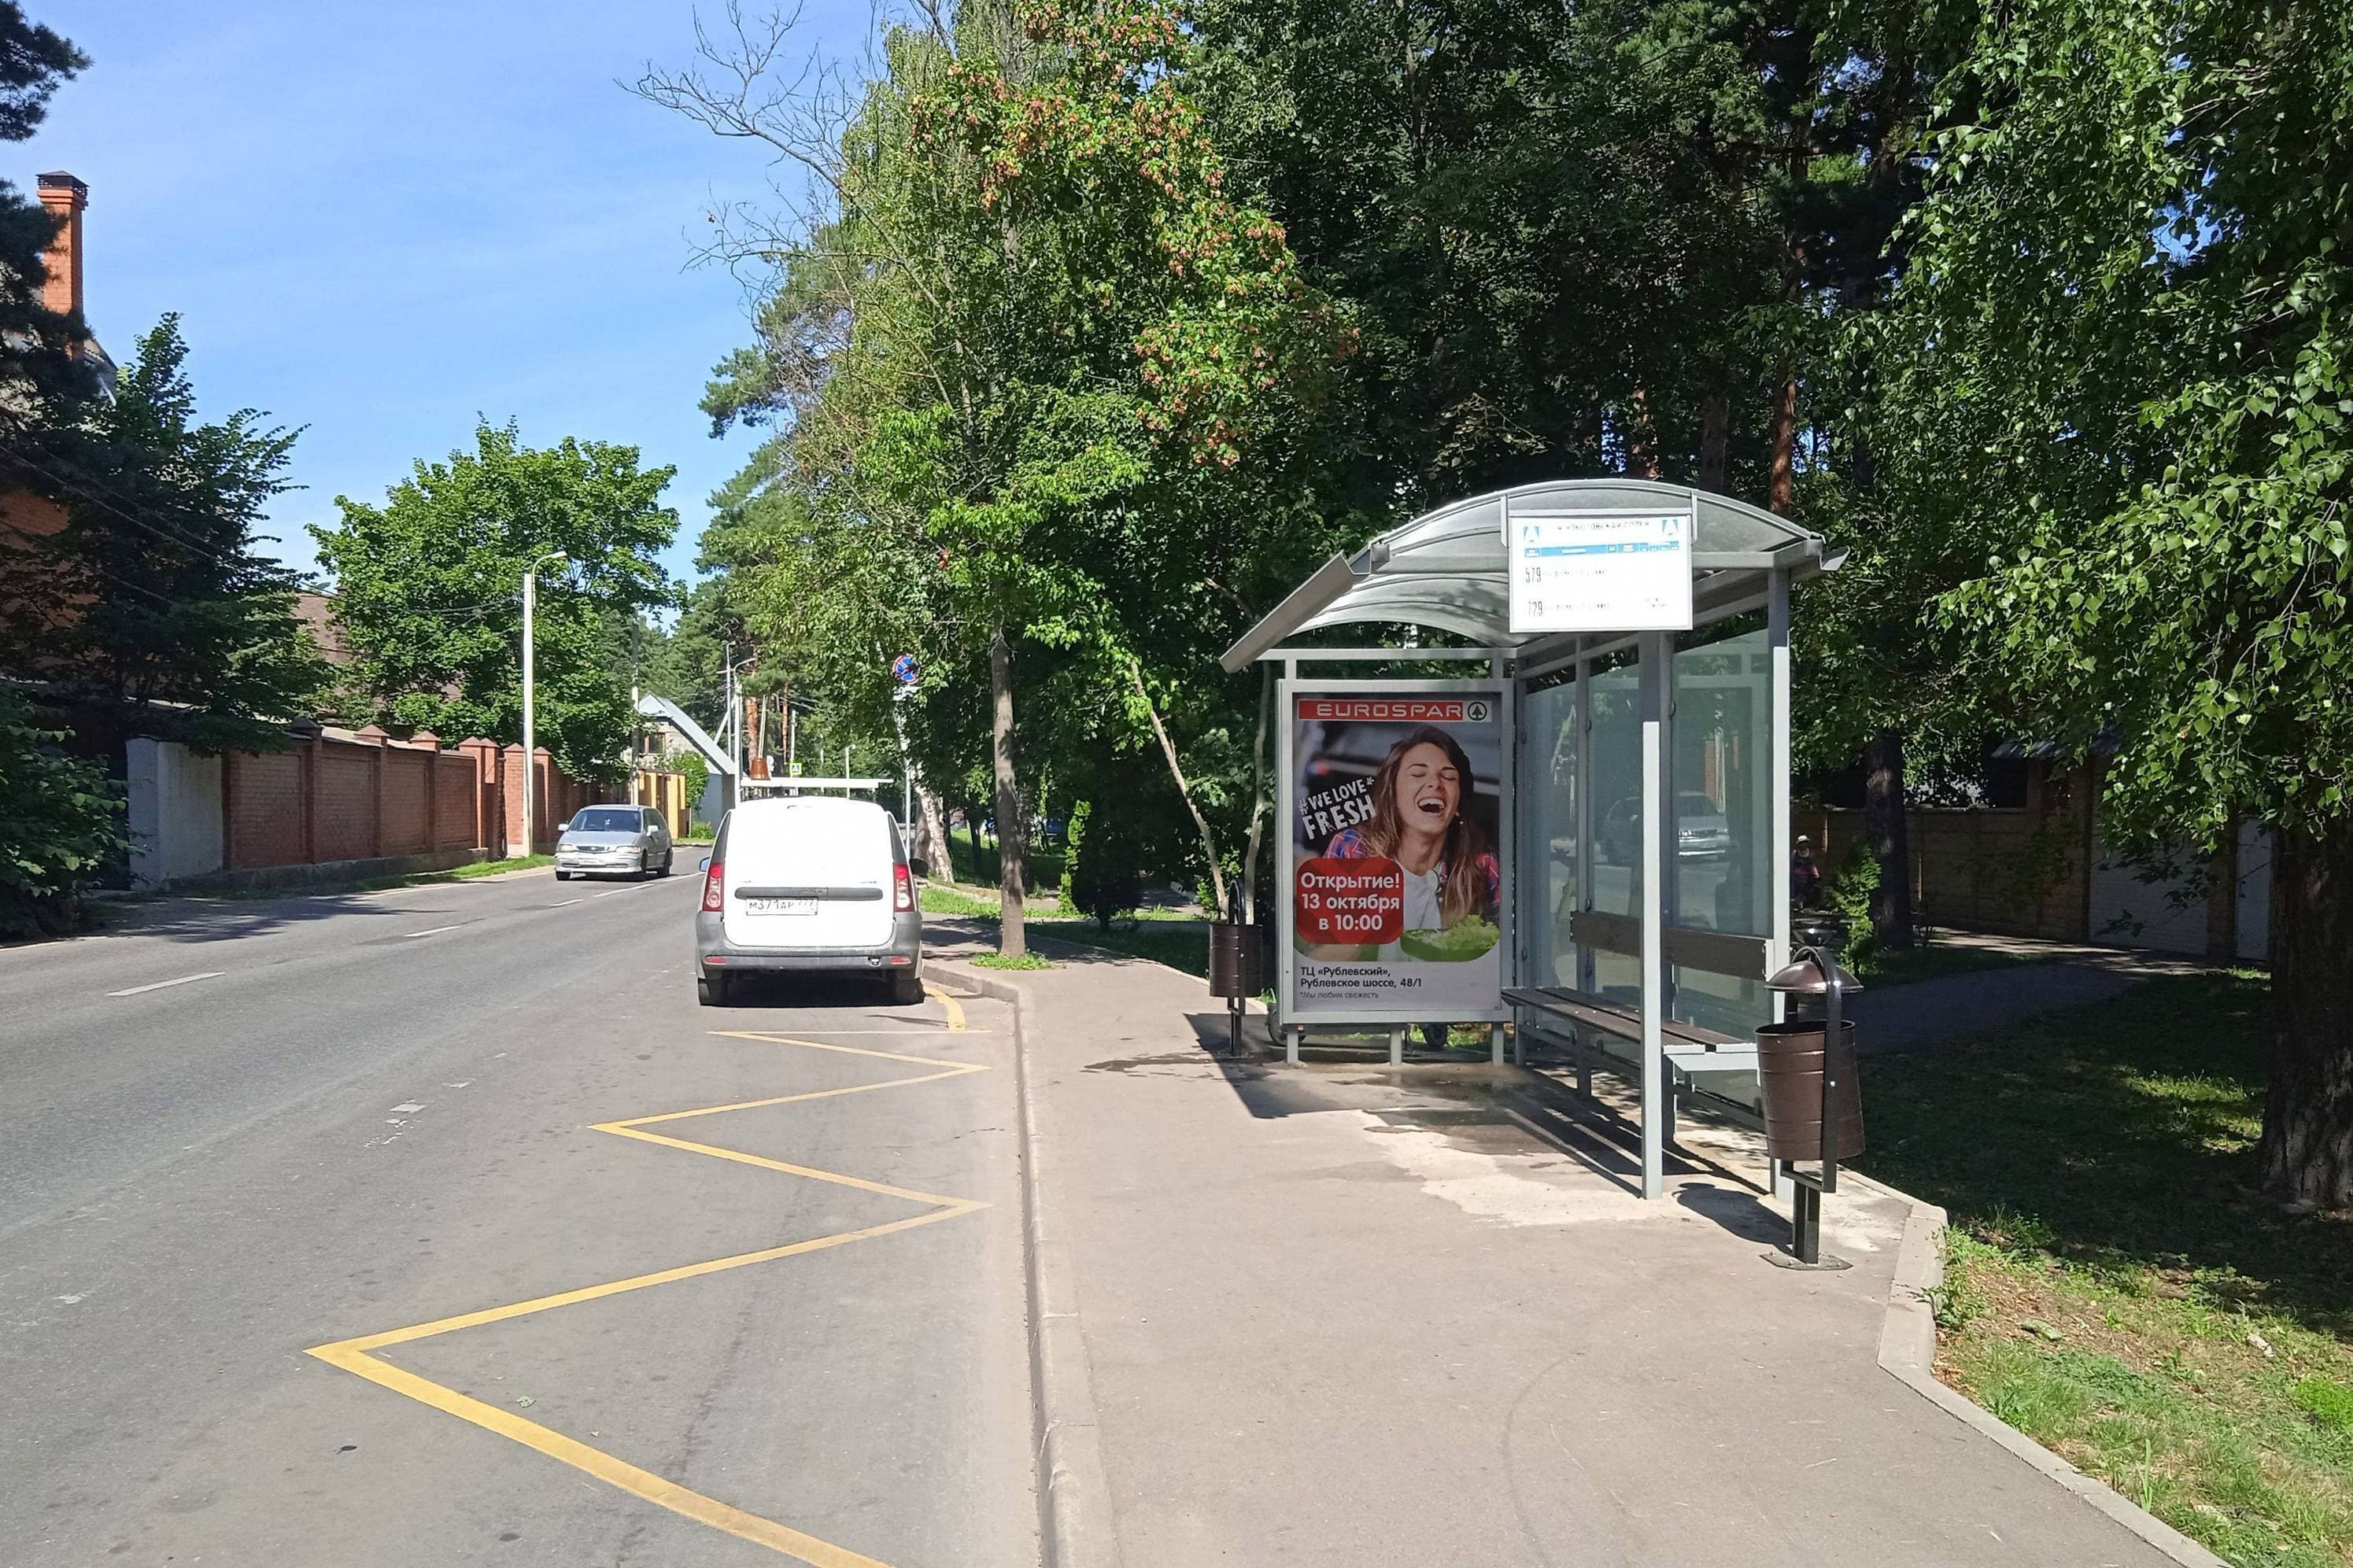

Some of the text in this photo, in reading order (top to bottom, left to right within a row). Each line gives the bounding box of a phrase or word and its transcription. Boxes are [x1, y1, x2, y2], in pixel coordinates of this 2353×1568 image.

[1525, 566, 1542, 584] 579
[1527, 600, 1543, 617] 729
[1316, 703, 1462, 718] EUROSPAR
[1302, 795, 1376, 840] FRESH
[1301, 872, 1400, 892] Открытие!
[1302, 893, 1400, 913] 13 октября
[1319, 914, 1383, 930] в 10:00
[1301, 967, 1391, 978] ТЦ «Рублевский»,
[1300, 979, 1361, 989] Рублевское
[1400, 978, 1422, 988] 48/1
